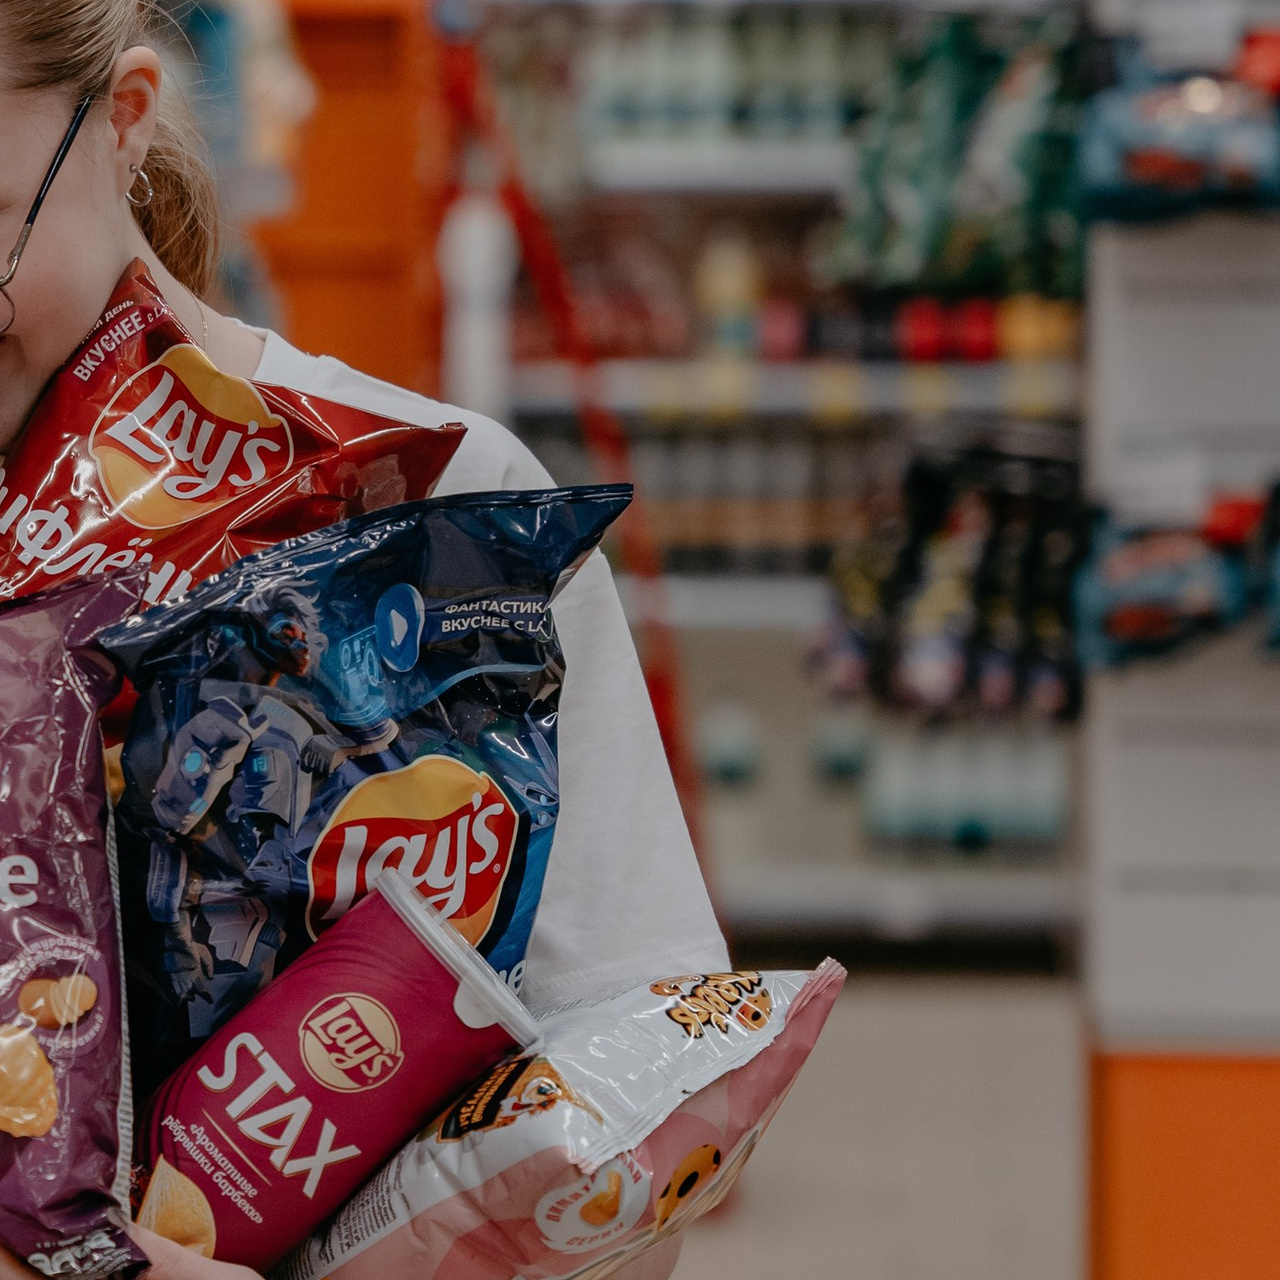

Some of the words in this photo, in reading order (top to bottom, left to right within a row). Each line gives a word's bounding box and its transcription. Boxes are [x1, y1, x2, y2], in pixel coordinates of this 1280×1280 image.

[72, 311, 146, 382] ВКУСНЕЕ
[104, 299, 135, 322] ДЕНЬ
[104, 370, 282, 500] Lay's
[441, 615, 510, 633] ВКУСНЕЕ
[307, 999, 394, 1078] Lay's
[196, 1031, 362, 1200] STAX
[161, 1114, 215, 1175] рёбрышки
[212, 1170, 264, 1224] барбекю»
[189, 1123, 258, 1199] «Ароматные
